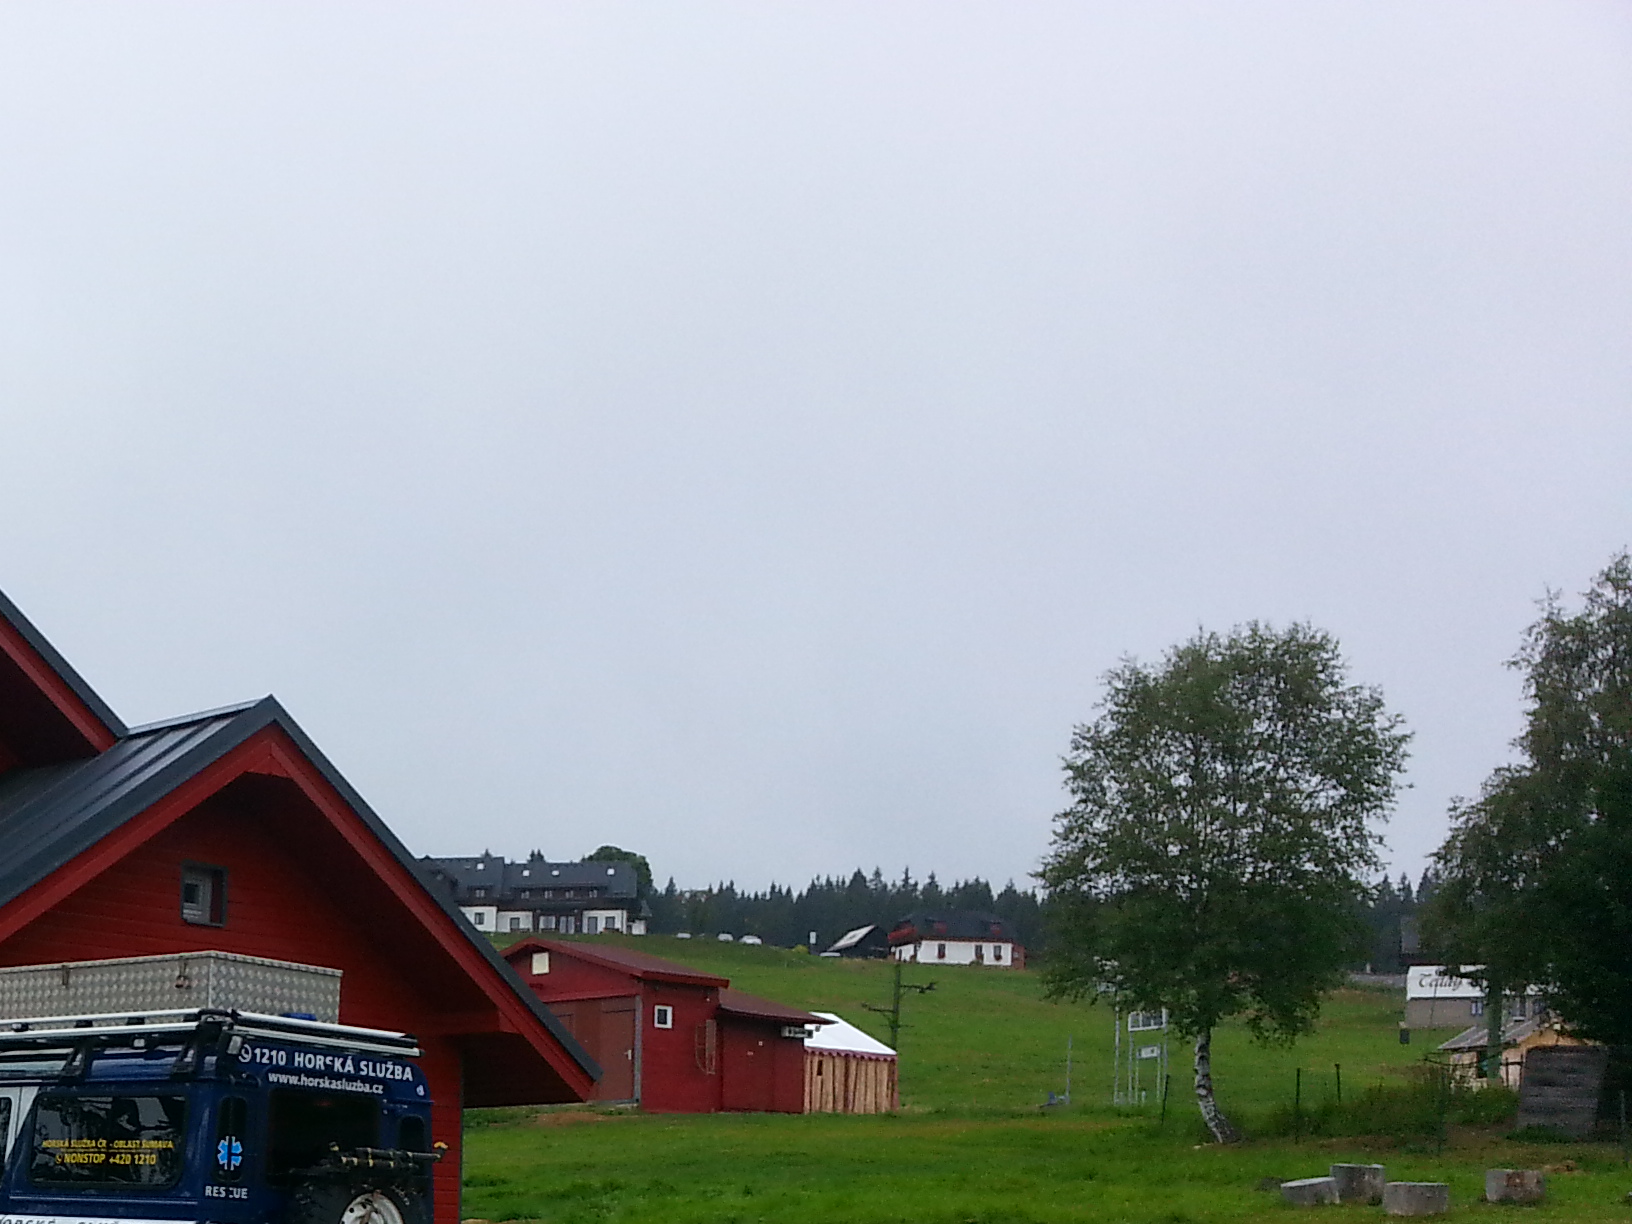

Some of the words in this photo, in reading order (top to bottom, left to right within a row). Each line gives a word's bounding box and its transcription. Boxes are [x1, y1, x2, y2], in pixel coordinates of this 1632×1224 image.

[254, 1047, 287, 1066] 1210
[359, 1060, 414, 1082] SLUŽBA
[267, 1071, 384, 1095] www.horskasluzba.cz
[63, 1153, 106, 1165] NONSTOP
[109, 1154, 132, 1165] +420
[134, 1154, 157, 1166] 1210
